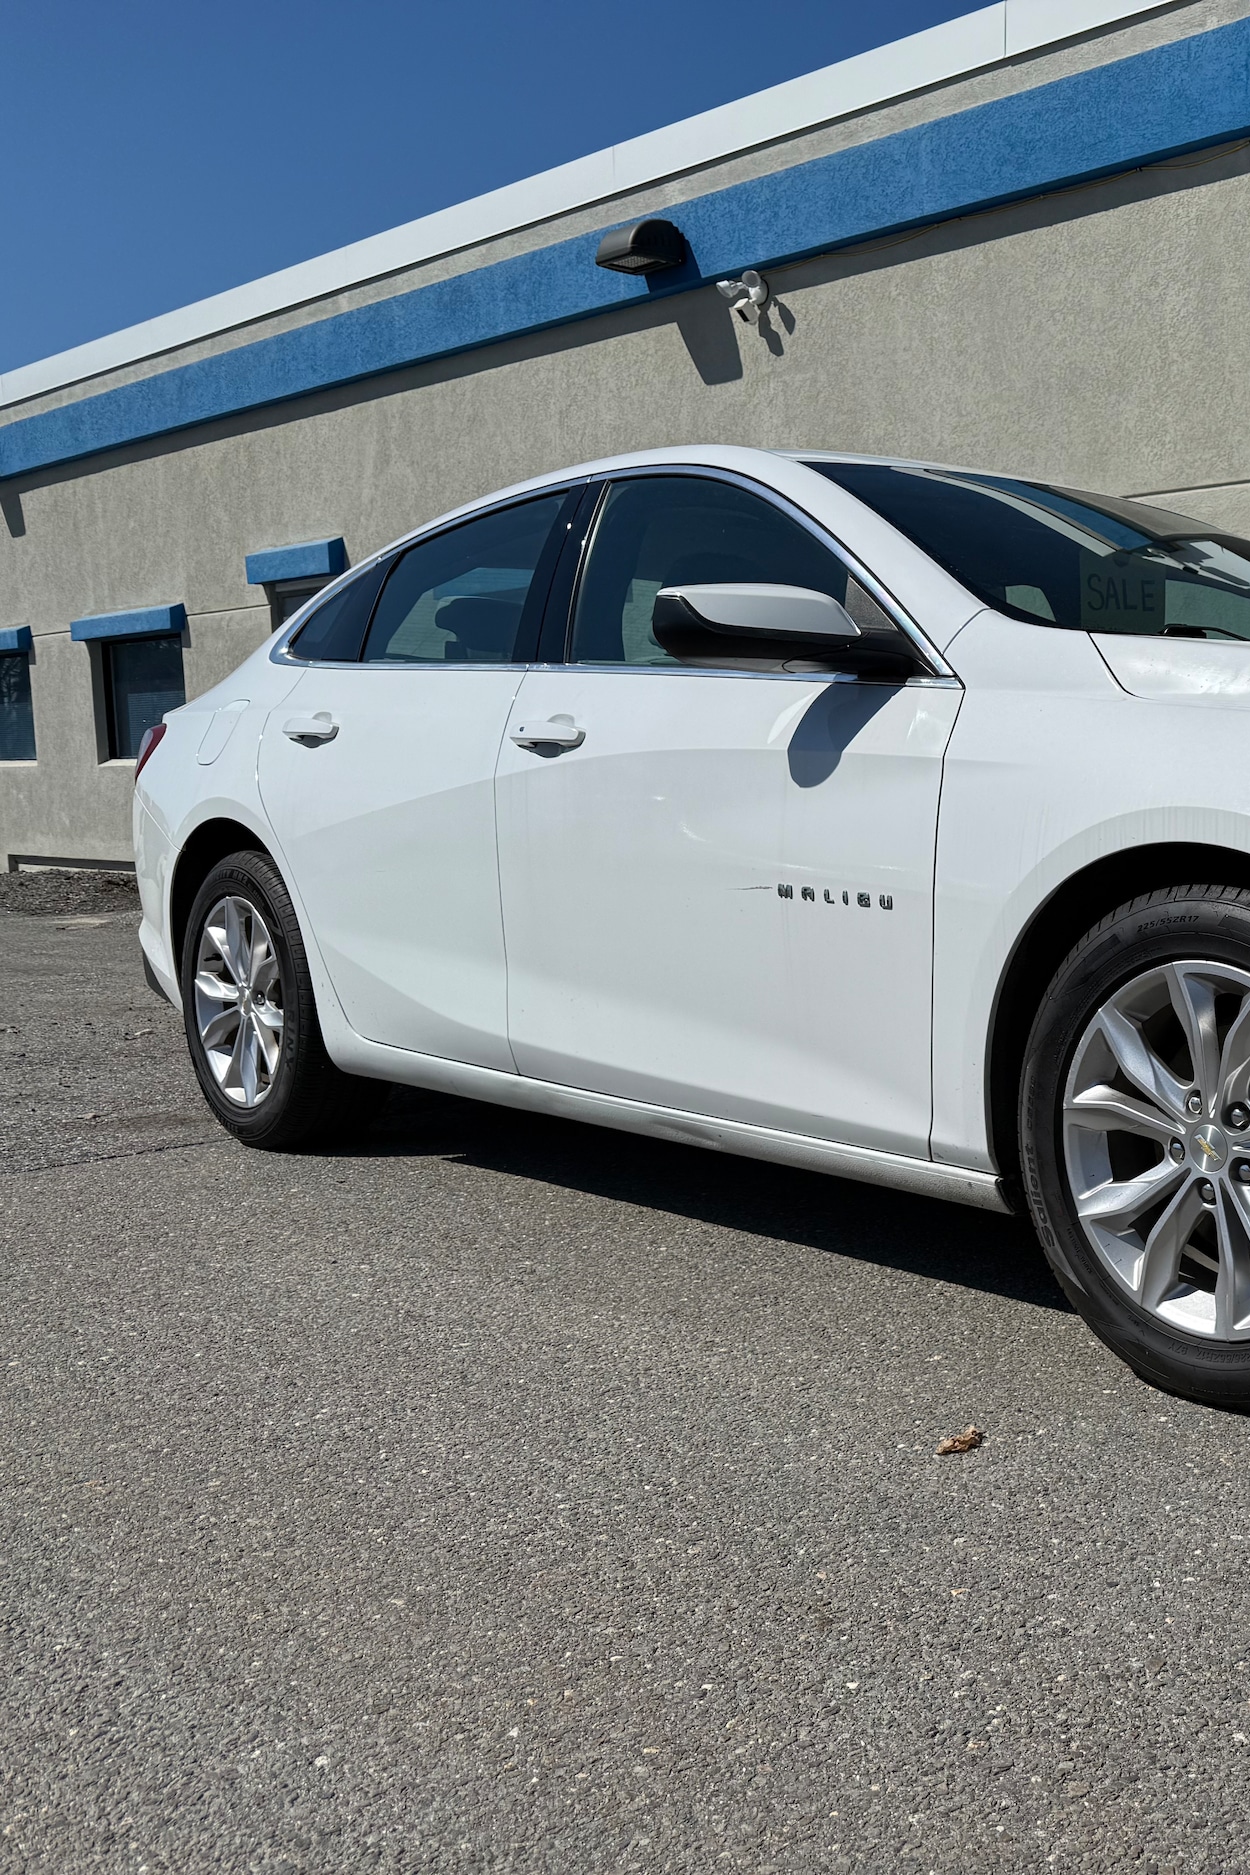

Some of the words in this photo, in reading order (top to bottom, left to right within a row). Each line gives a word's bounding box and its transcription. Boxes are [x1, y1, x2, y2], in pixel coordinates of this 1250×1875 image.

[1087, 573, 1156, 611] SALE
[777, 883, 893, 910] MALIBU
[1137, 915, 1200, 933] 225/55ZR17
